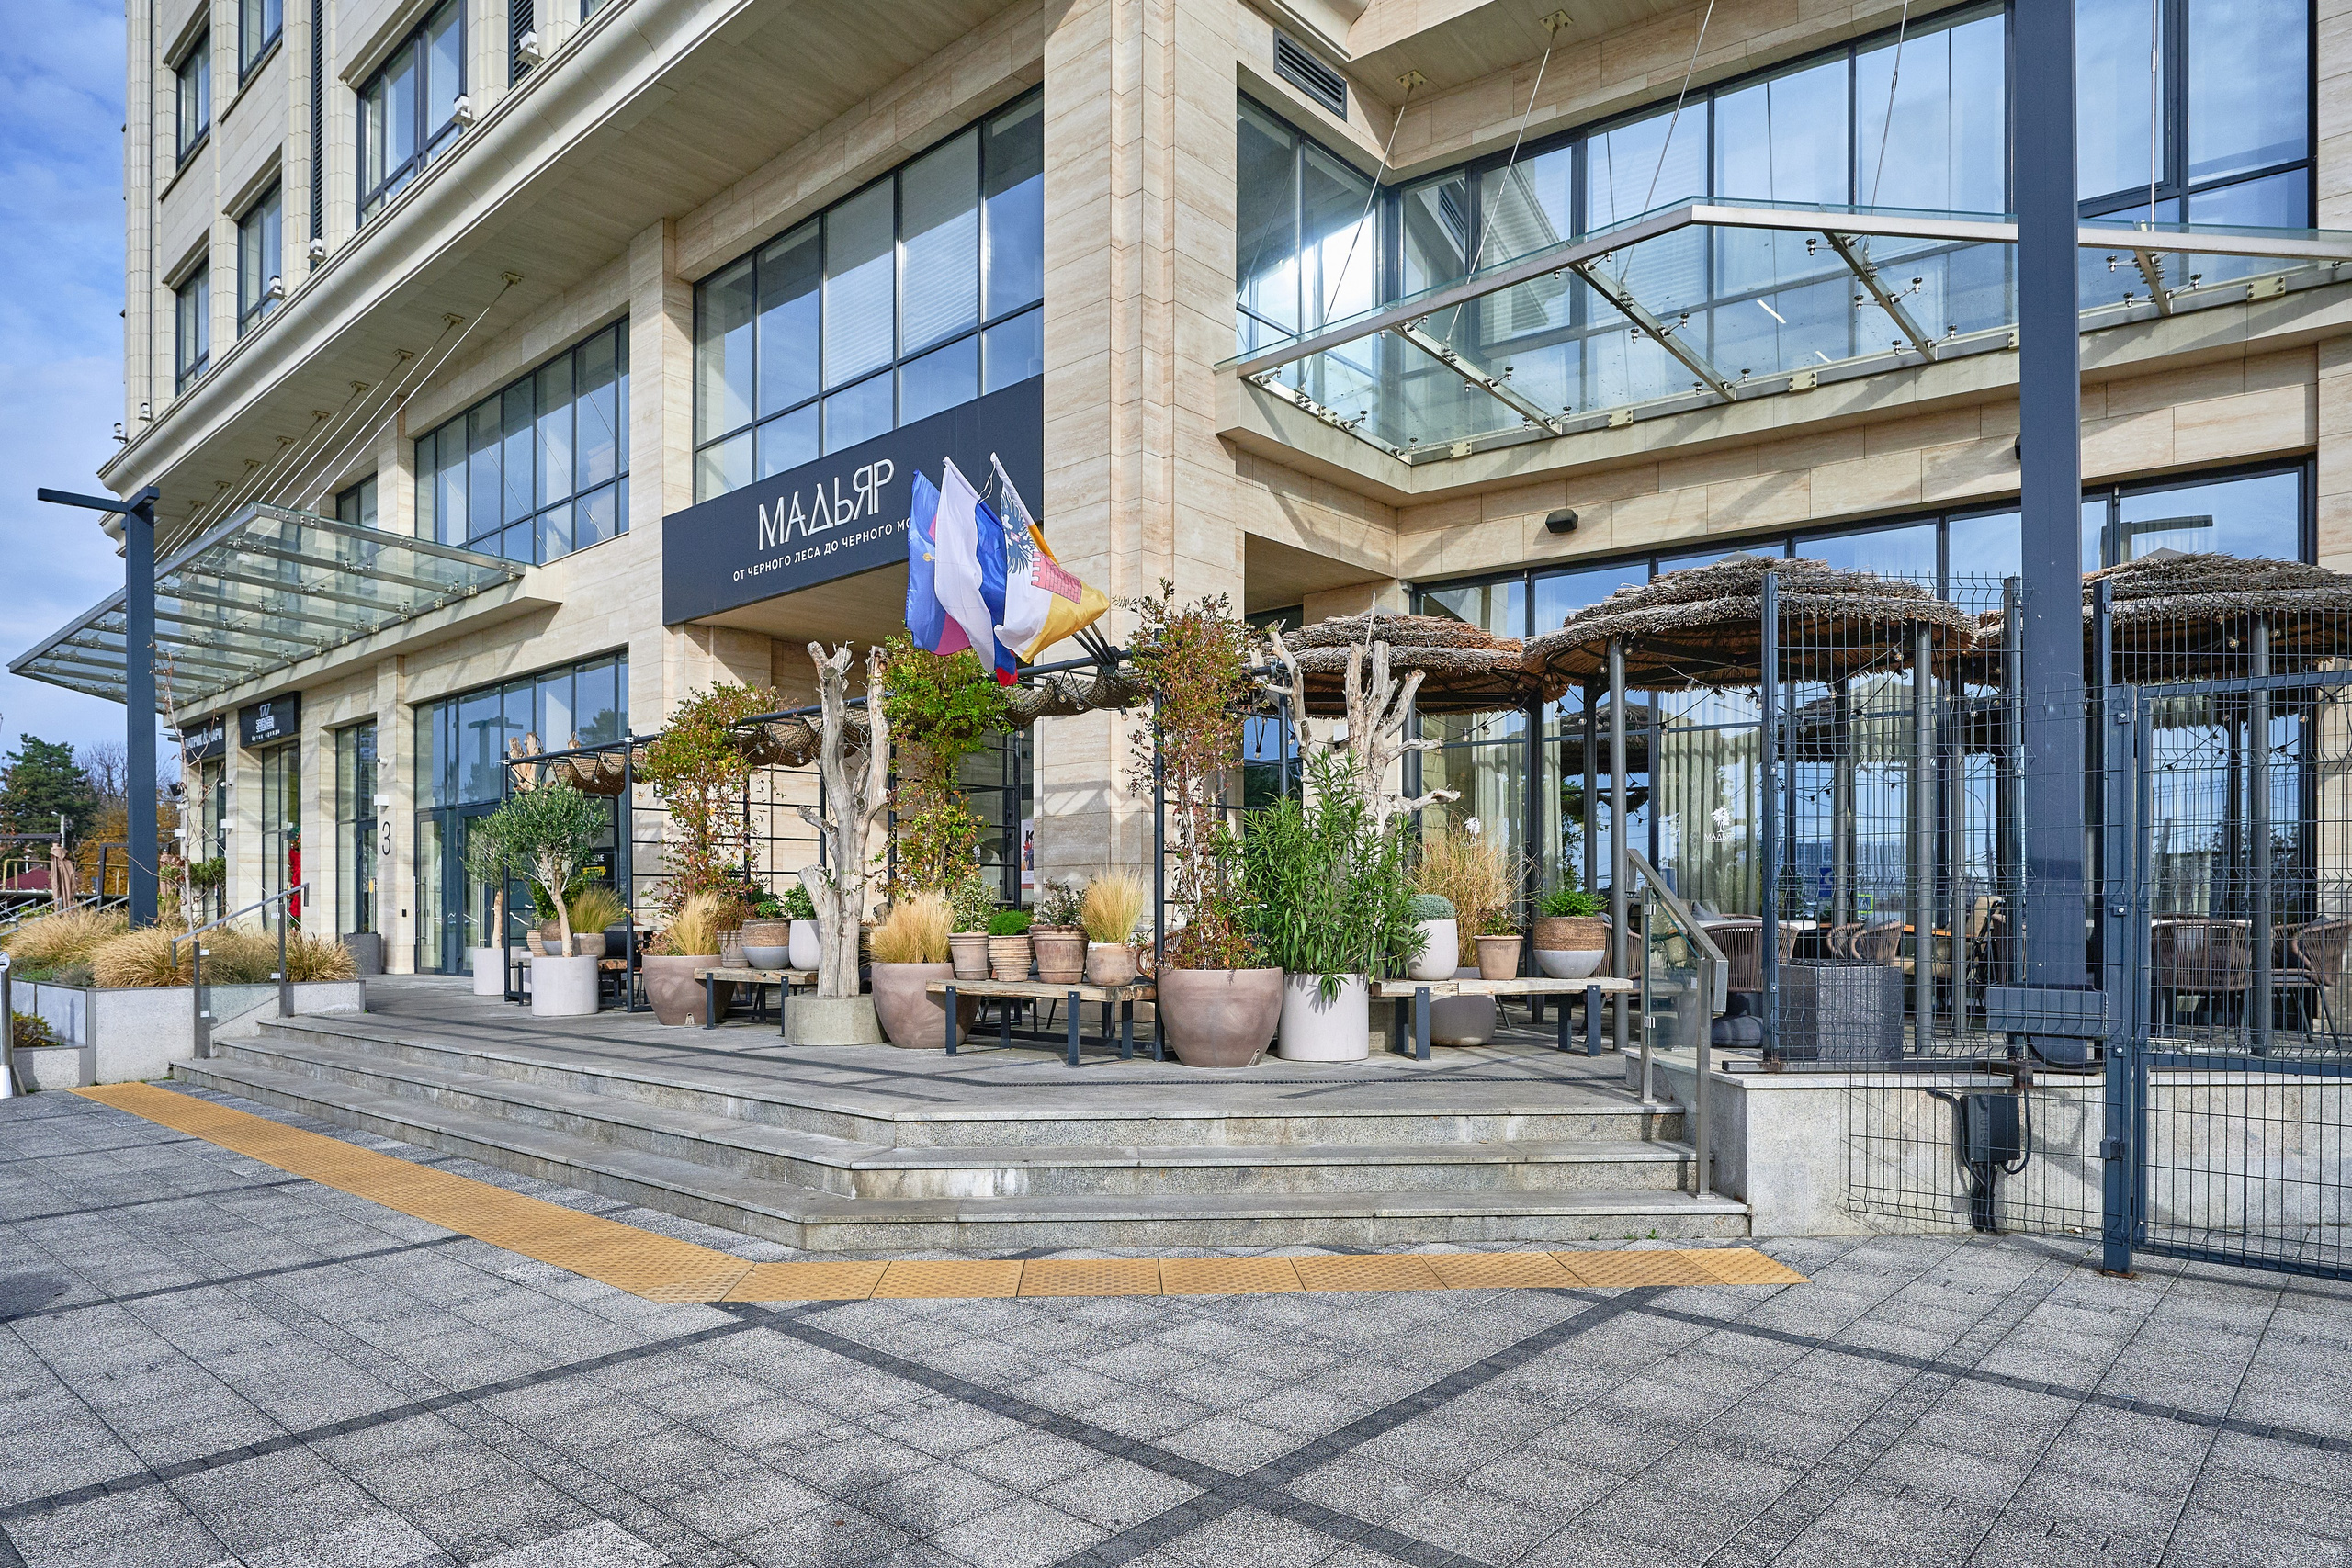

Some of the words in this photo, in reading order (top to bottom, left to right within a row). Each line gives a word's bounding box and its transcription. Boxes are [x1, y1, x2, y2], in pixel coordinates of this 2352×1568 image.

[759, 458, 895, 551] МАДЬЯР
[733, 569, 745, 581] ОТ
[748, 555, 791, 577] ЧЕРНОГО
[794, 546, 820, 563] ЛЕСА
[823, 540, 839, 556] ДО
[842, 523, 893, 548] ЧЕРНОГО
[381, 820, 391, 856] 3
